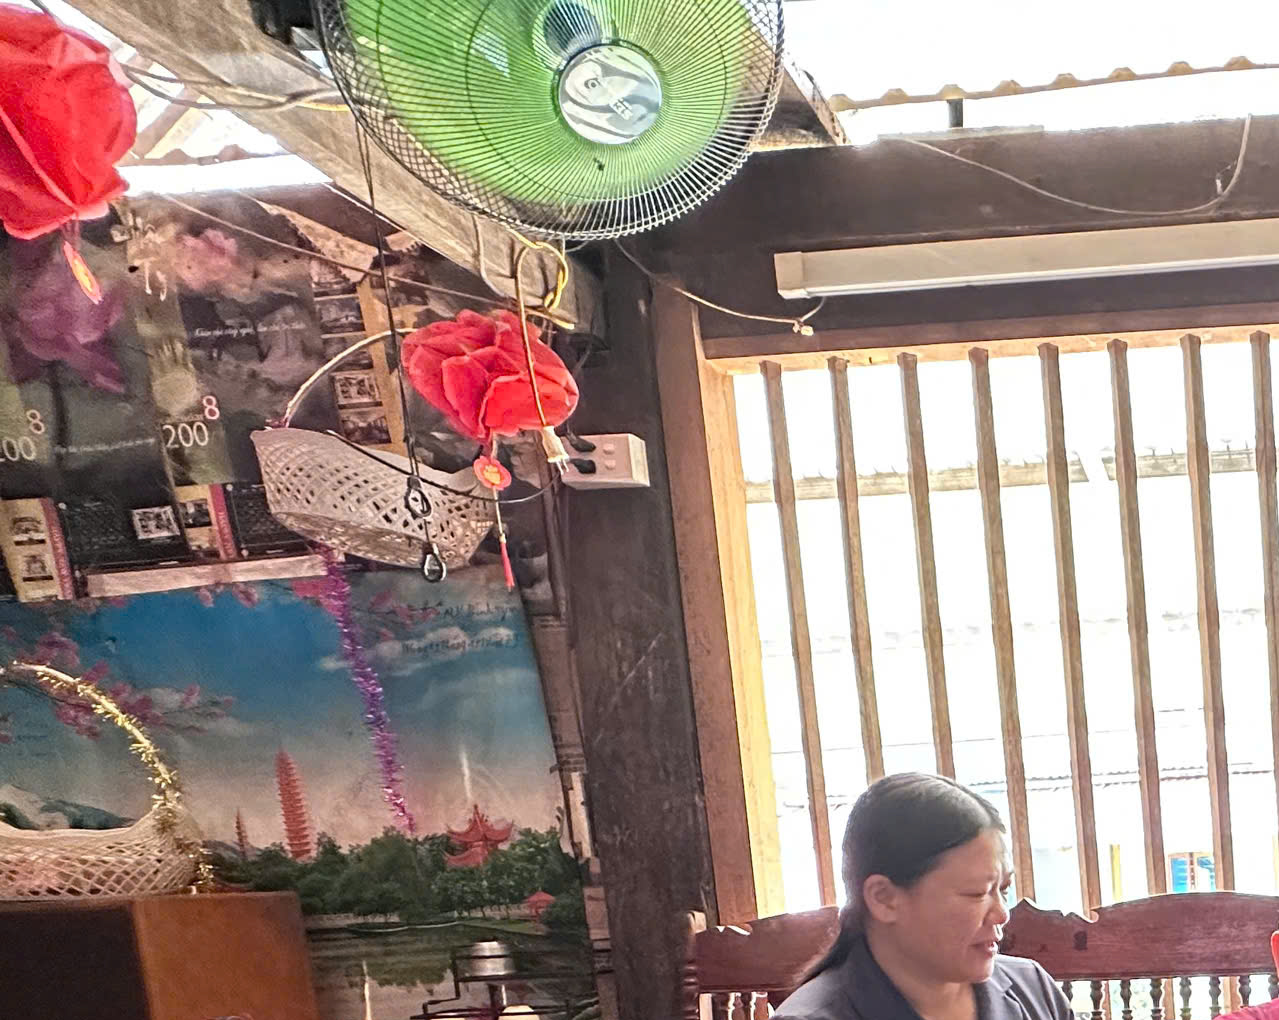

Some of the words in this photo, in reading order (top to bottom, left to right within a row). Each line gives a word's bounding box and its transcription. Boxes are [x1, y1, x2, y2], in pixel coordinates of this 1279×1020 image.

[202, 395, 220, 420] 8
[26, 409, 45, 434] 8
[162, 421, 209, 448] 200
